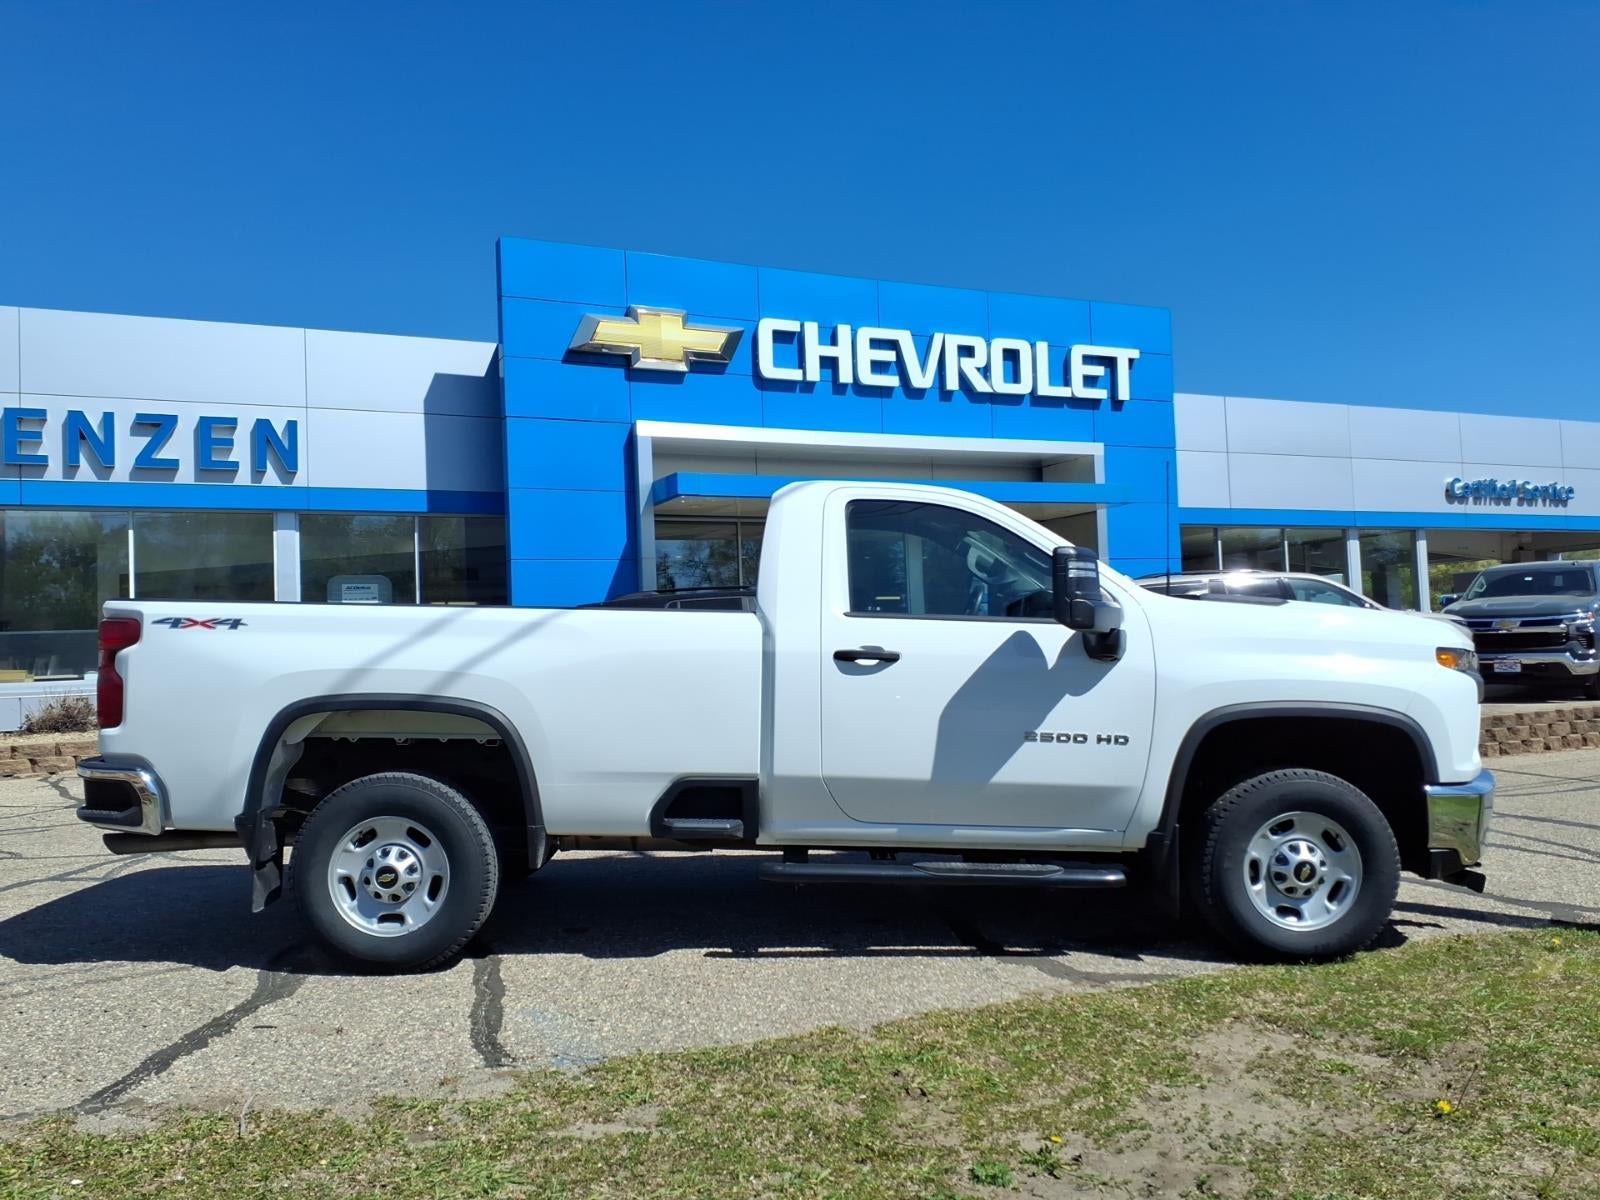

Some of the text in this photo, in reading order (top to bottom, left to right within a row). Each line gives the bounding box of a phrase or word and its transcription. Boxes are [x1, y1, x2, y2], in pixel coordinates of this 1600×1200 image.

[757, 317, 1140, 401] CHEVROLET
[3, 407, 298, 473] ENZEN
[1448, 477, 1575, 501] Certified Service
[1023, 731, 1130, 746] 2500 HD
